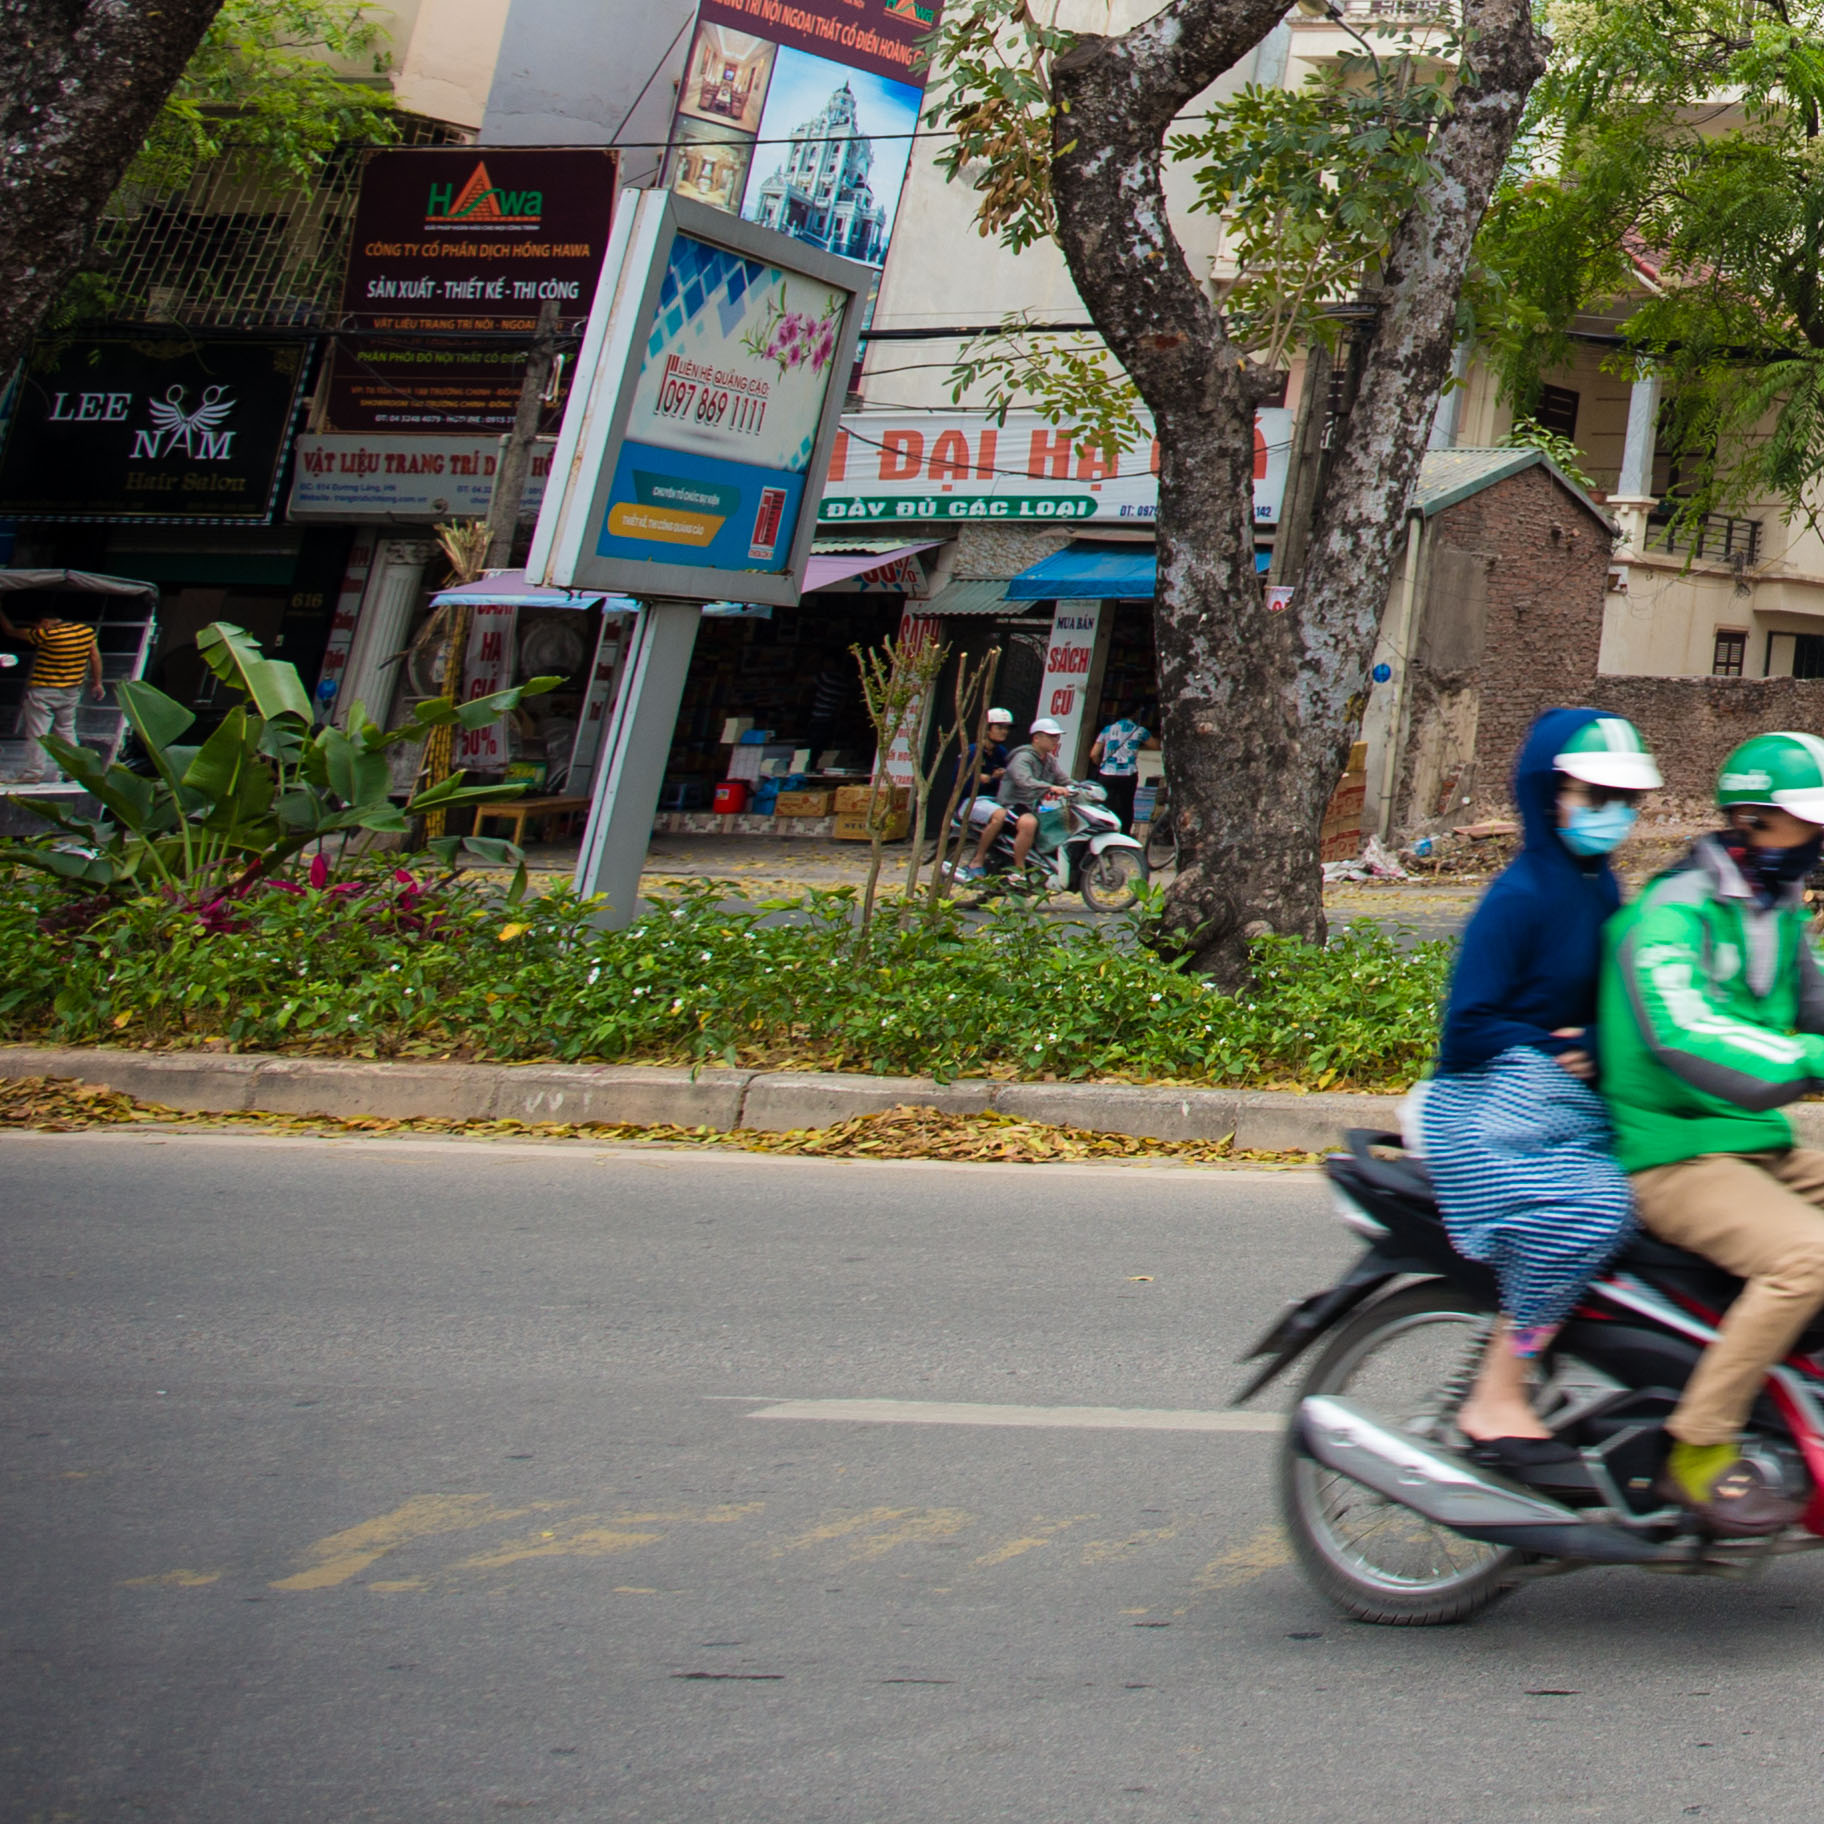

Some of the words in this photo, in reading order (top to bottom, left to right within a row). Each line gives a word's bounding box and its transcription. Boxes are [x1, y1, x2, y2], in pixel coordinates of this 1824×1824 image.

[781, 3, 816, 37] NGOẠI
[367, 275, 397, 299] SẢN
[398, 276, 436, 299] XUẤT
[444, 276, 484, 299] THIẾT
[485, 276, 507, 299] KẾ
[513, 281, 537, 299] THI
[538, 278, 580, 299] CÔNG
[49, 392, 133, 422] LEE
[663, 379, 697, 416] 097
[697, 387, 729, 424] 869
[730, 395, 767, 433] 1111
[128, 424, 238, 460] NAM
[304, 446, 336, 477] VẬT
[340, 448, 379, 477] LIỆU
[384, 453, 445, 475] TRANG
[450, 450, 478, 476] TRÍ
[876, 430, 998, 492] ĐẠI
[122, 471, 178, 491] Hair
[181, 471, 246, 491] Salon
[826, 497, 886, 517] ĐẦY
[894, 497, 937, 517] ĐỦ
[948, 497, 1008, 517] CÁC
[1019, 499, 1088, 519] LOẠI
[1048, 641, 1092, 673] SÁCH
[1050, 684, 1076, 716] CŨ
